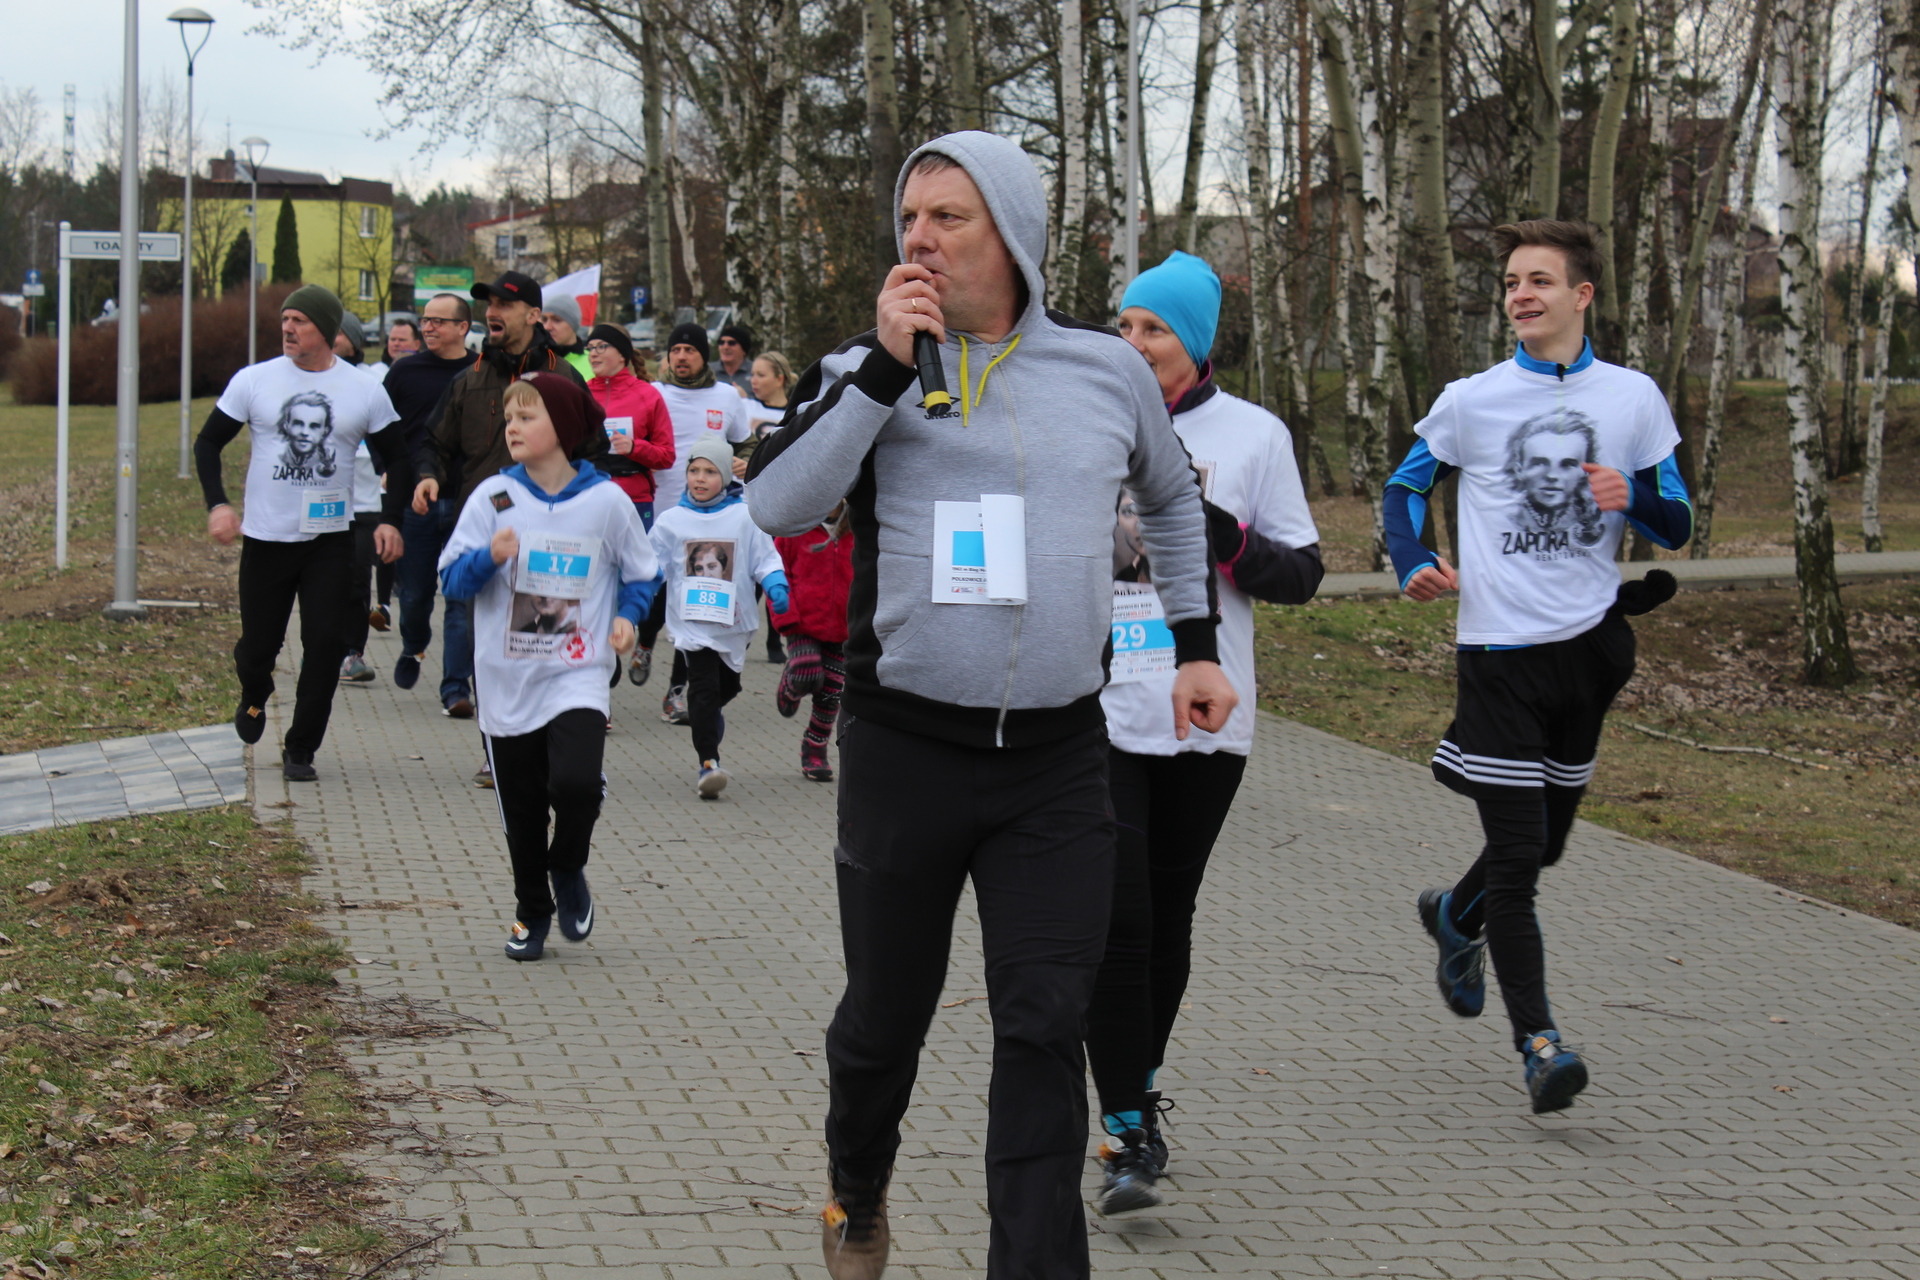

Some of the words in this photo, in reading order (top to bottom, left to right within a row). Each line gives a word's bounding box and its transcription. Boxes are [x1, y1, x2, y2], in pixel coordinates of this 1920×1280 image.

[272, 465, 314, 480] ZAPORA
[322, 503, 336, 516] 13
[1501, 530, 1568, 555] ZAPORA
[548, 555, 574, 574] 17
[698, 591, 717, 604] 88
[1112, 623, 1146, 650] 29
